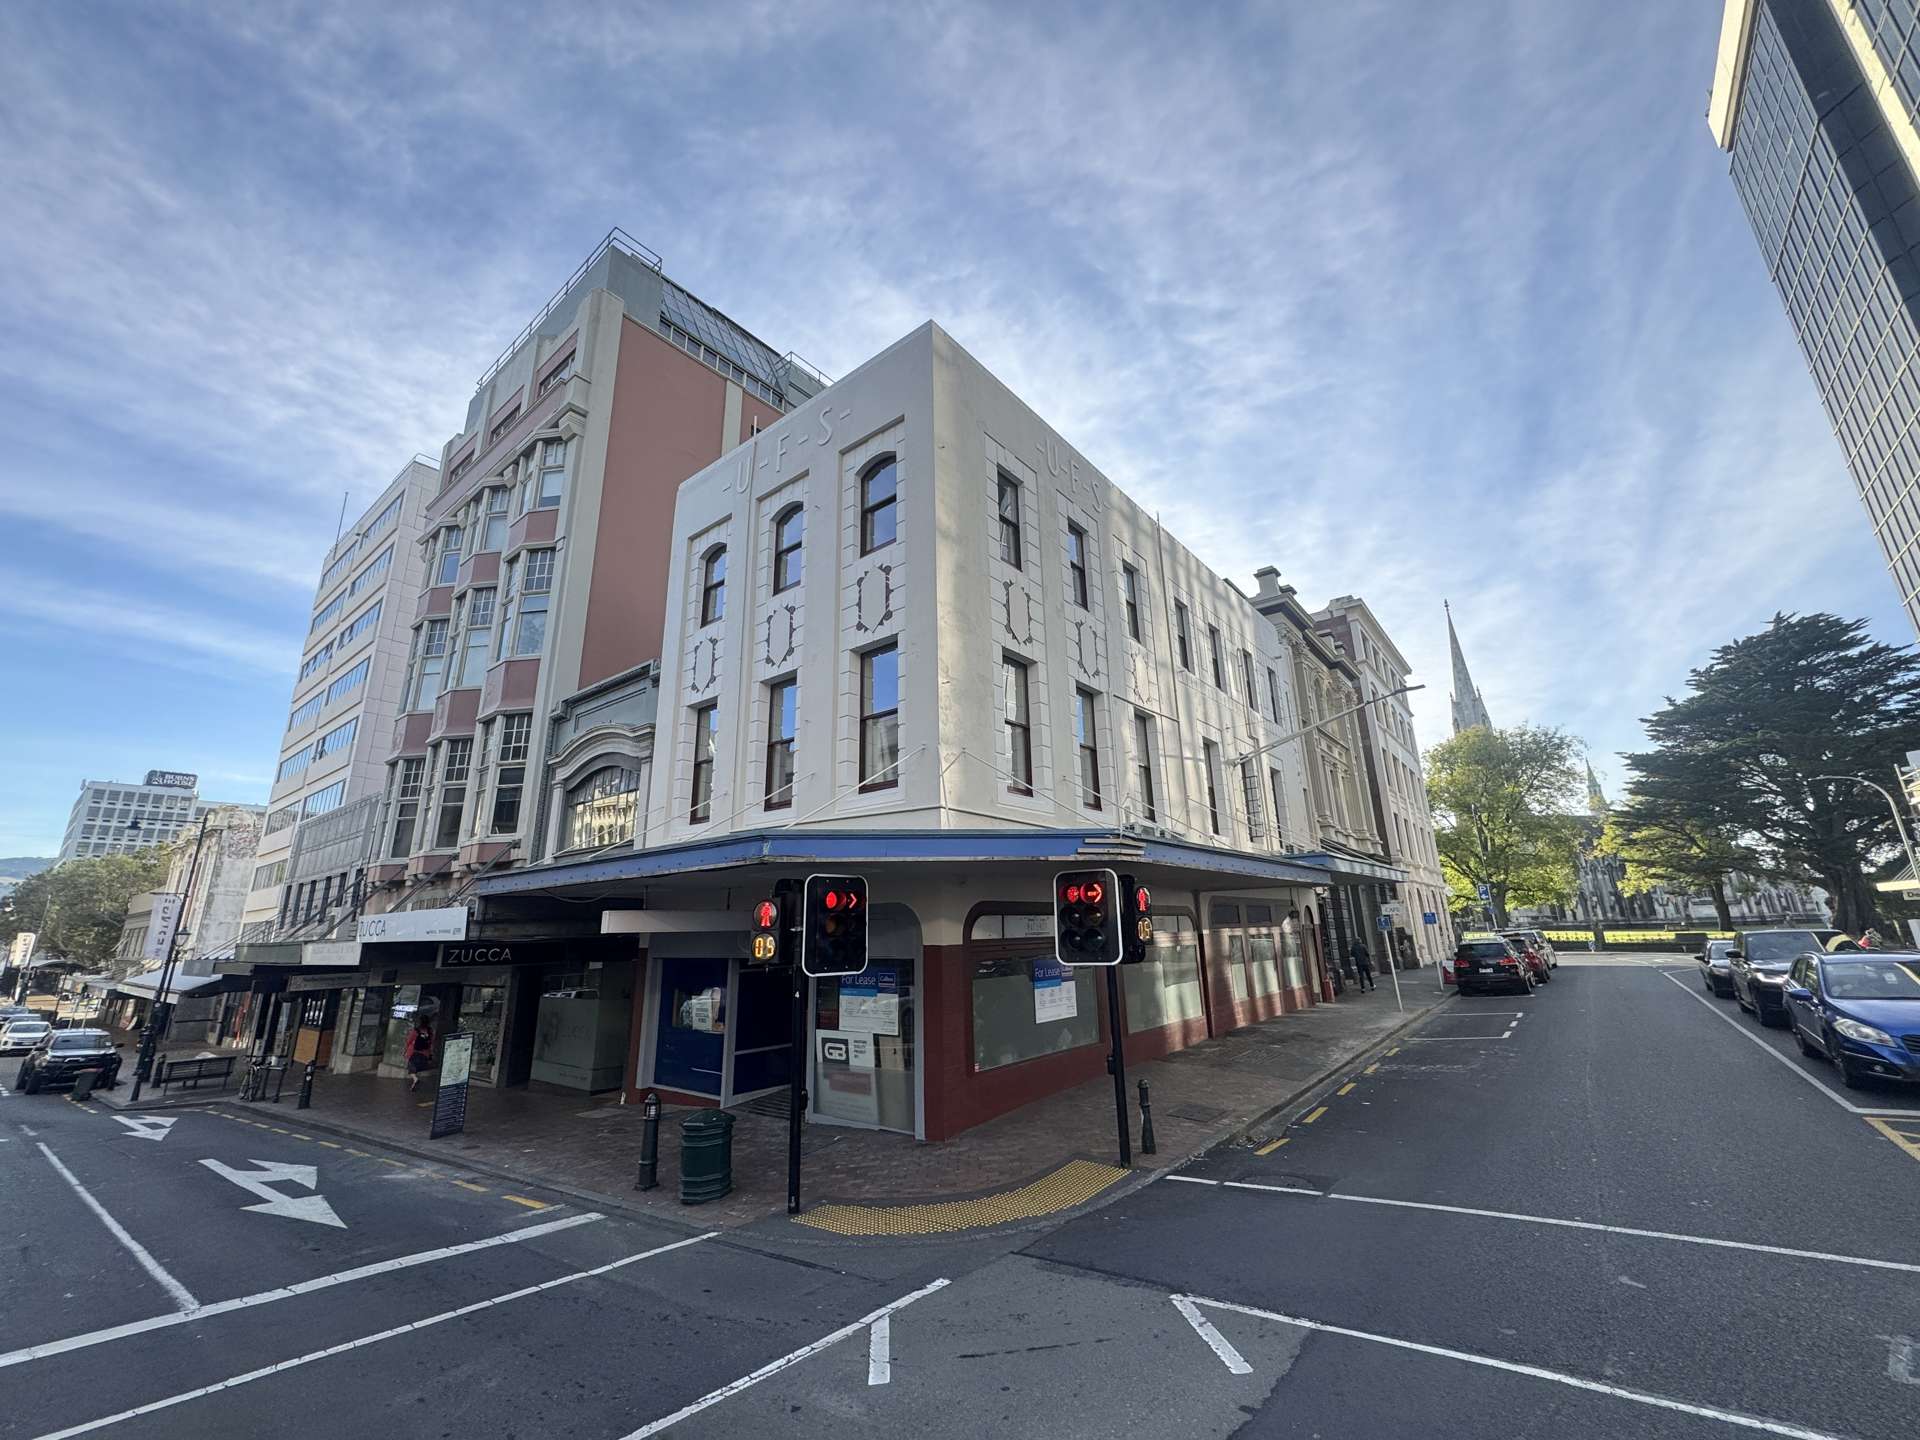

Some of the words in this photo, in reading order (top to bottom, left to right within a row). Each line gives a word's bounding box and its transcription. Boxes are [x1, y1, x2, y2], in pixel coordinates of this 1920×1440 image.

[163, 778, 194, 786] HOUSE
[447, 948, 512, 963] ZUCCA
[1034, 967, 1044, 978] For
[1044, 967, 1061, 977] Lease
[841, 975, 855, 985] For
[855, 974, 876, 985] Lease
